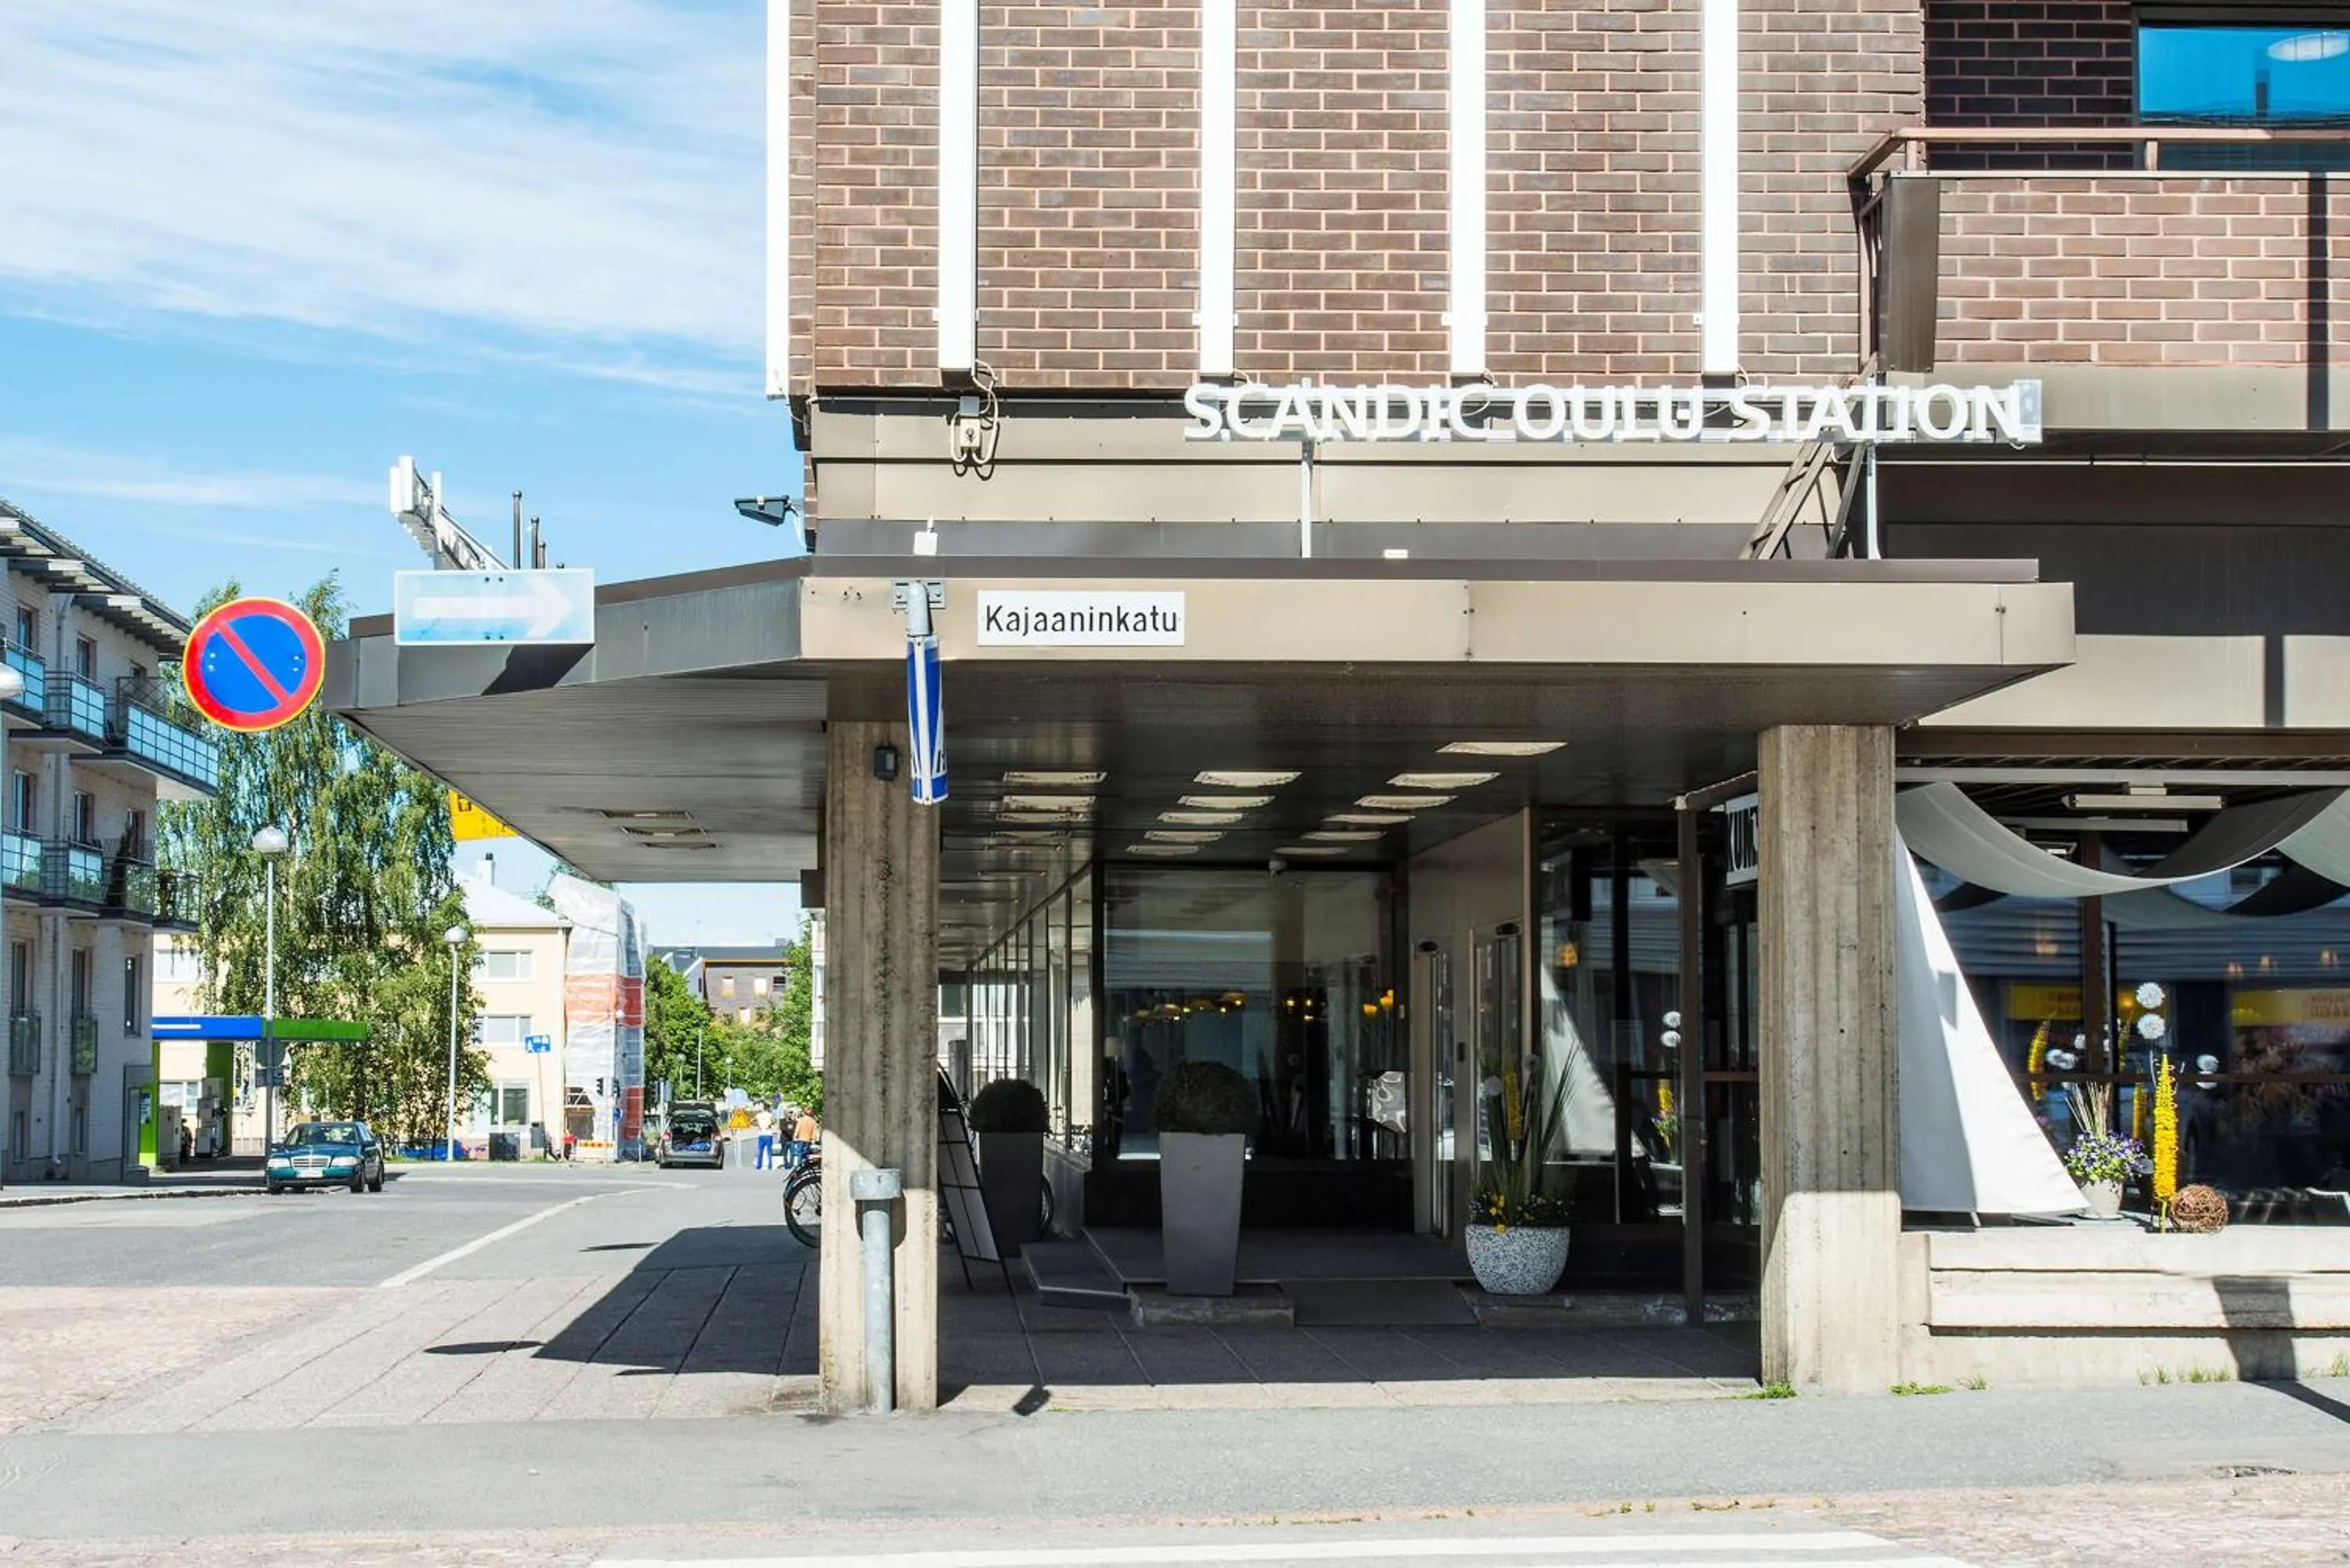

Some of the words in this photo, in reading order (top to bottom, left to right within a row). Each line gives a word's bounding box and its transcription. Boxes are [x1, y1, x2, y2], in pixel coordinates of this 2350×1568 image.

[1184, 382, 1488, 439] SCANDIC
[1513, 383, 1704, 439] OULU
[1729, 383, 2018, 439] STATION
[985, 605, 1177, 637] Kajaaninkatu
